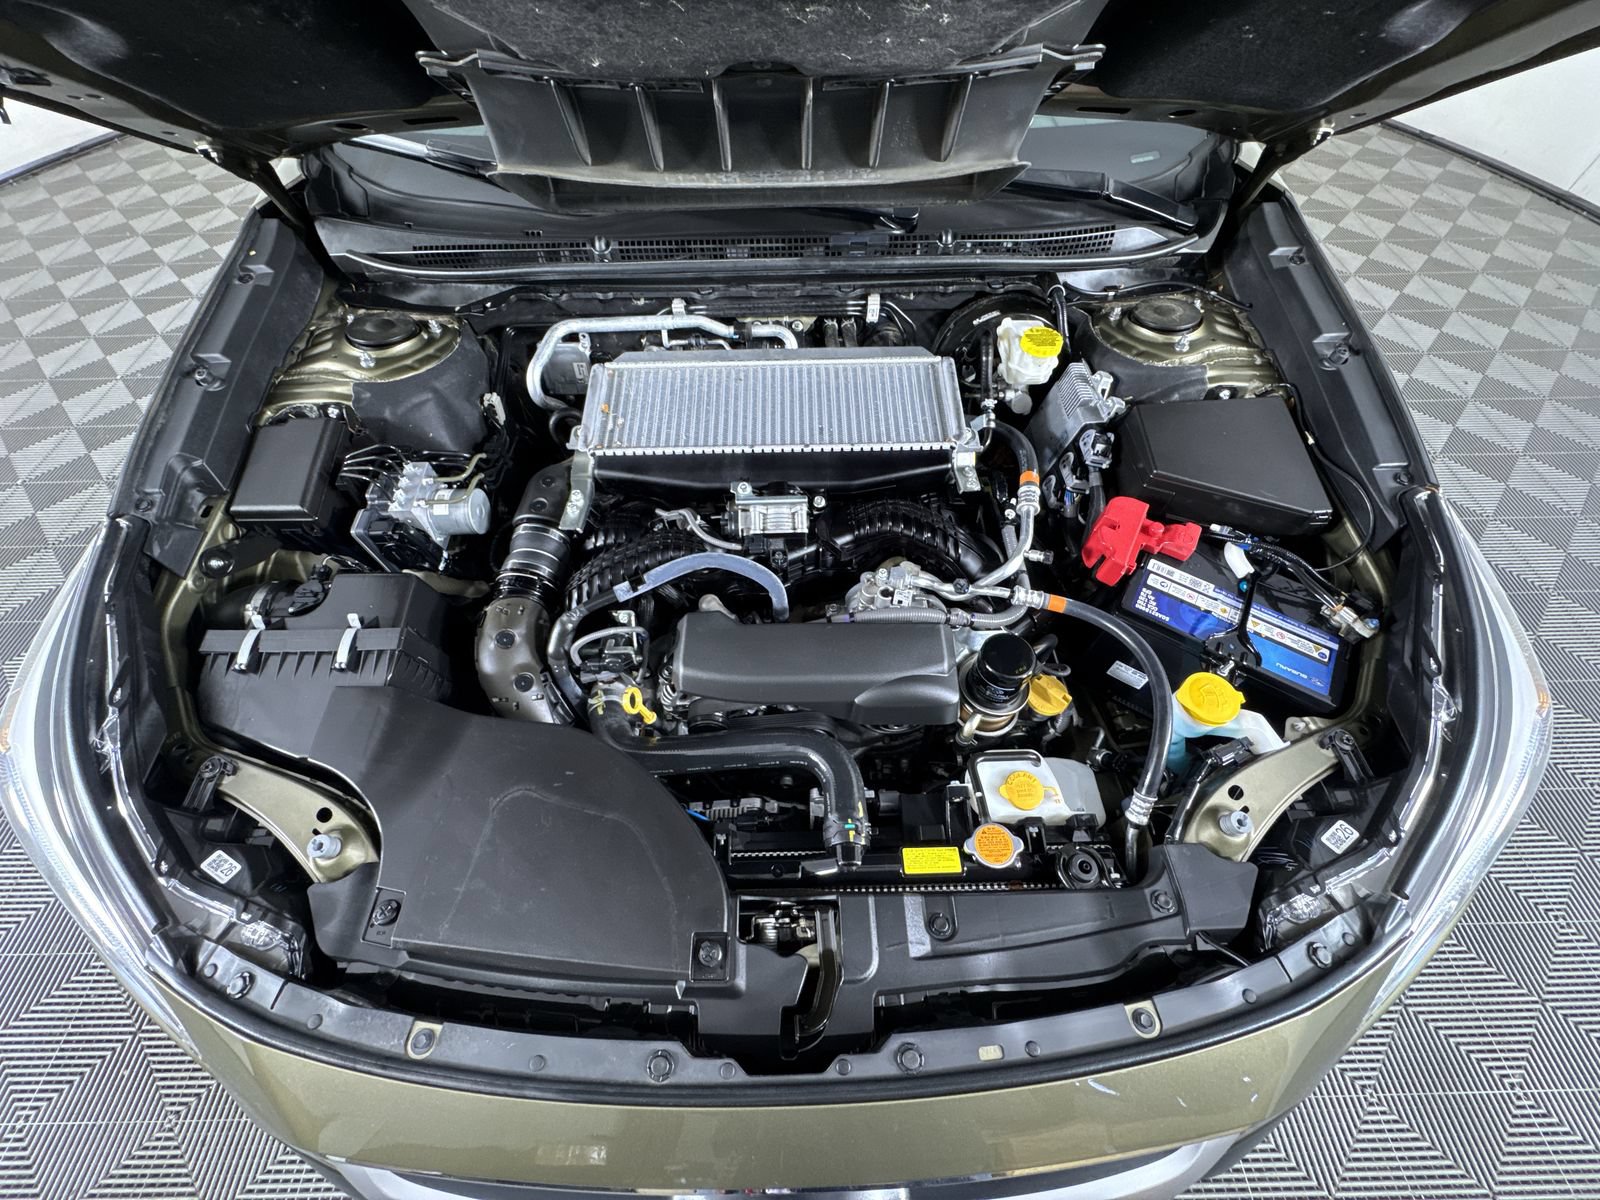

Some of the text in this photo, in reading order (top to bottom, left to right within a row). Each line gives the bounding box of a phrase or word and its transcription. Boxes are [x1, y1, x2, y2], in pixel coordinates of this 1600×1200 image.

[1275, 662, 1308, 679] SUBARU
[1335, 823, 1354, 840] 26
[220, 862, 237, 877] 26
